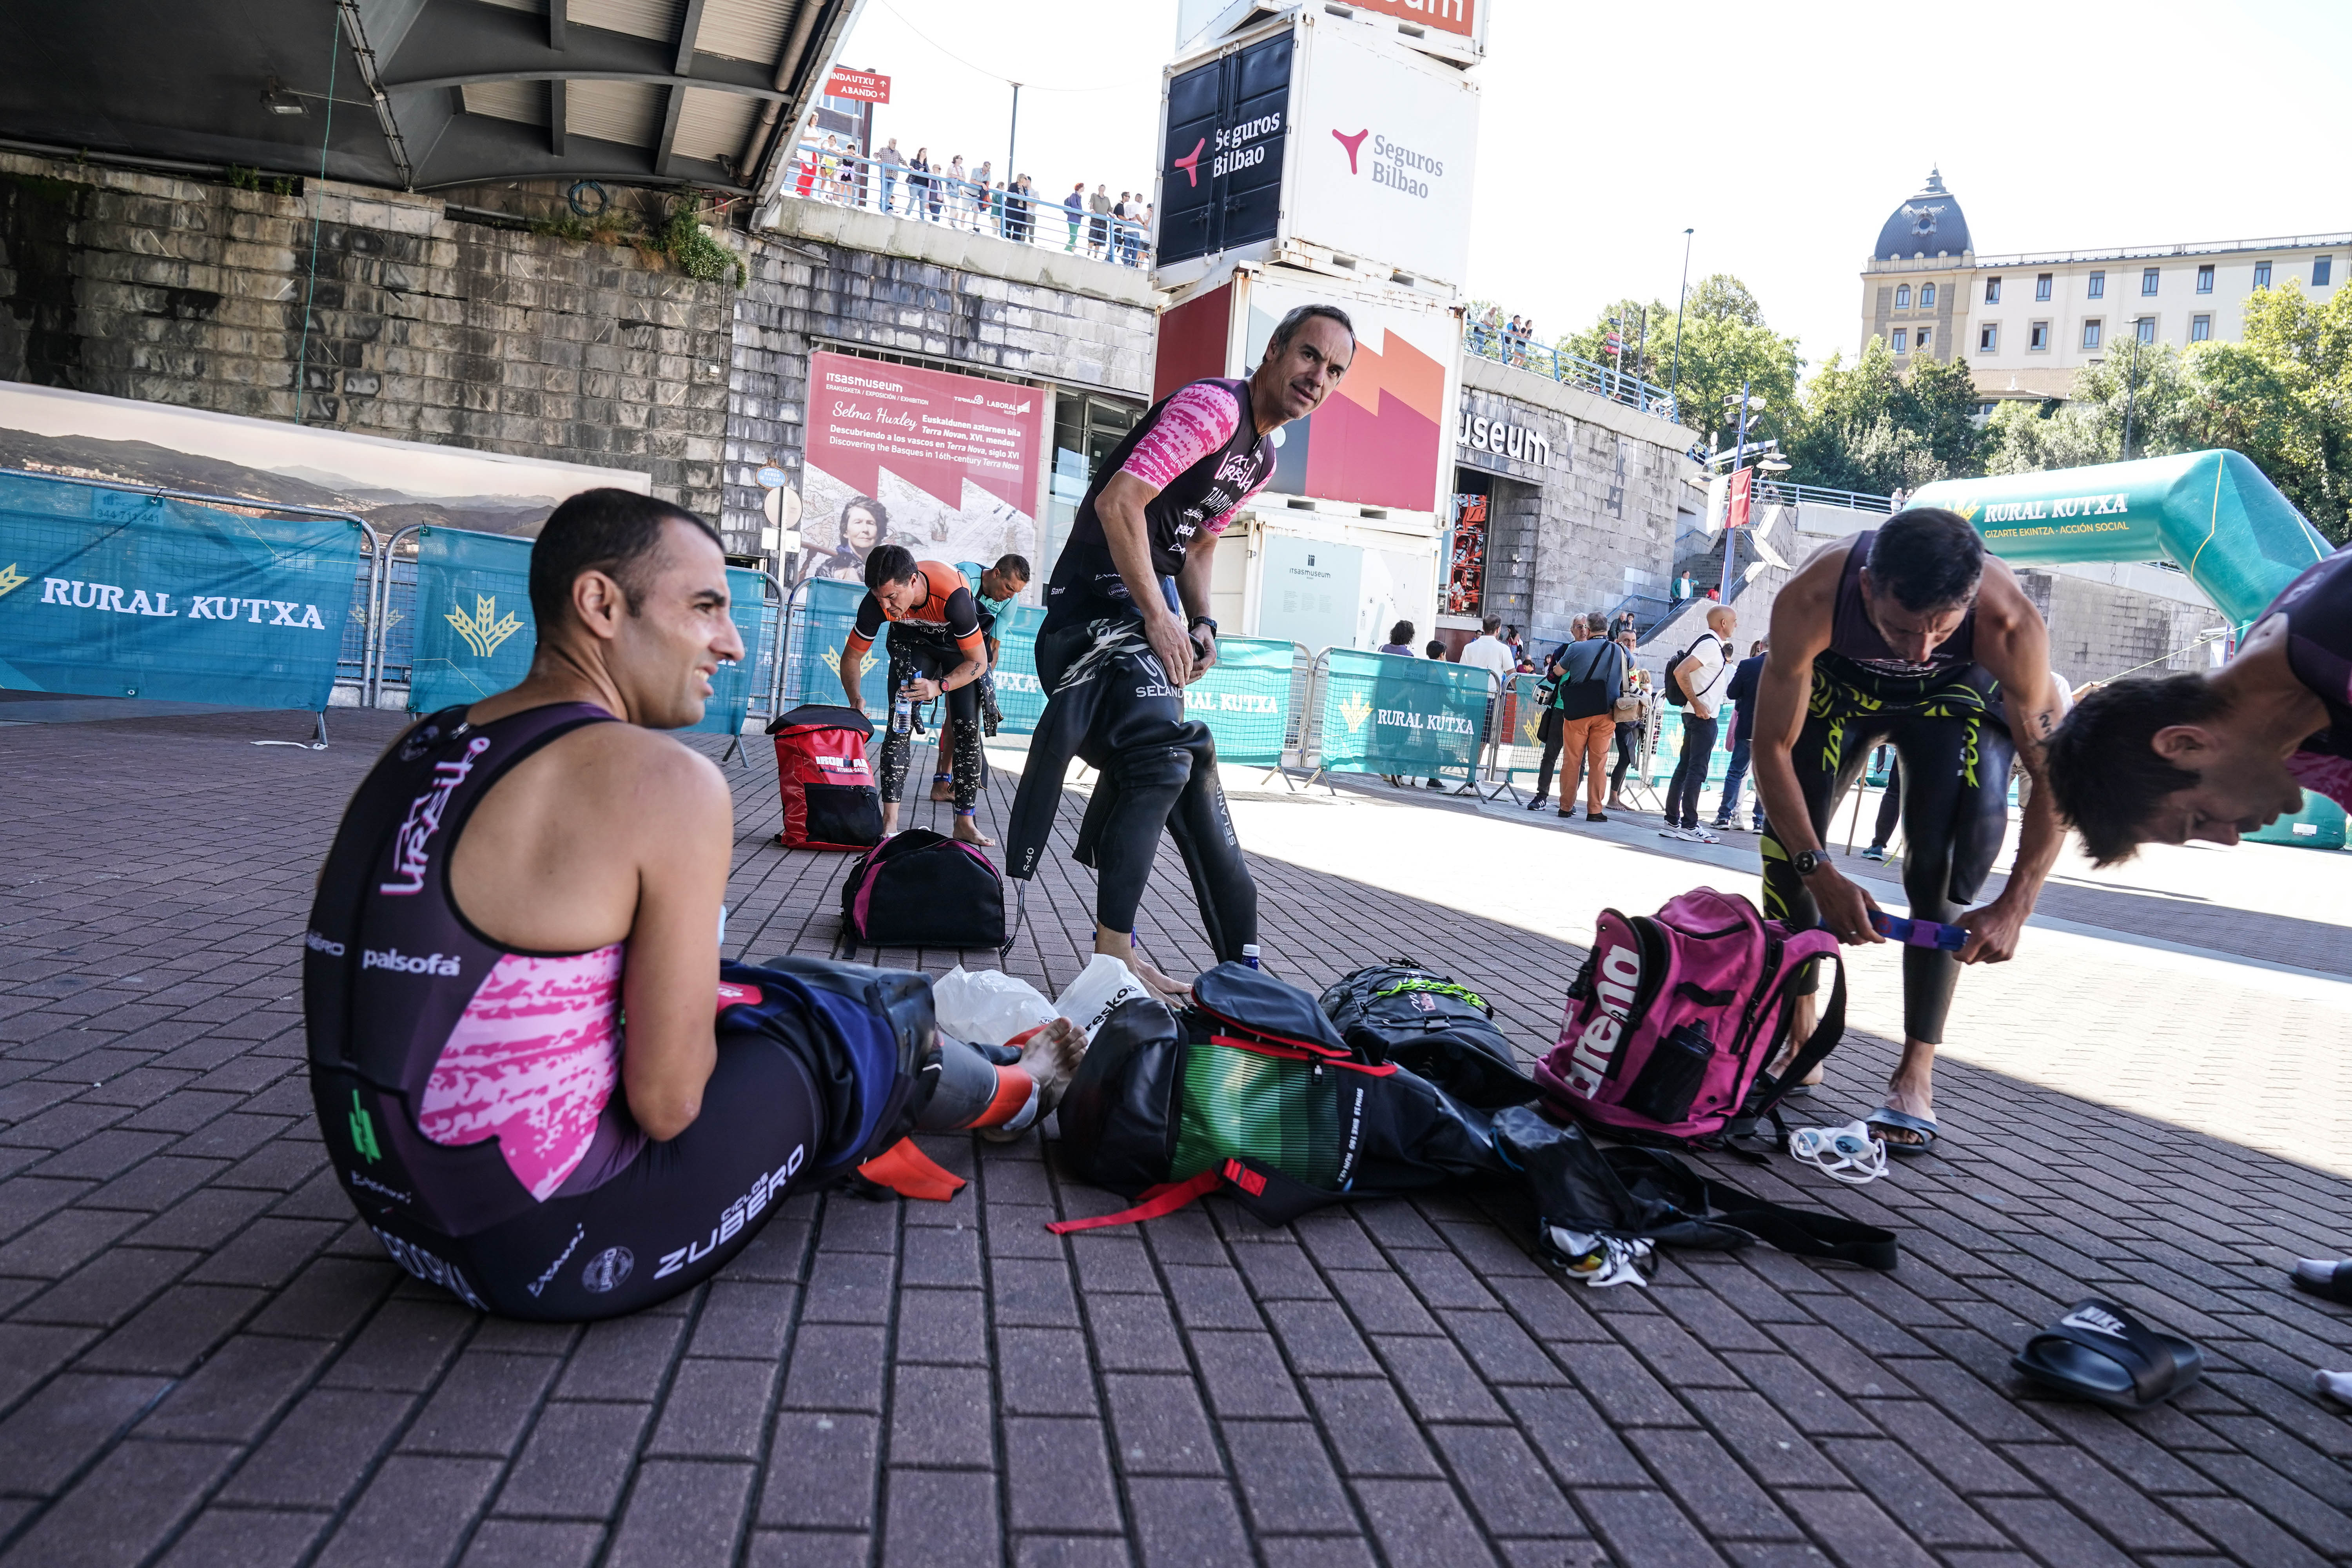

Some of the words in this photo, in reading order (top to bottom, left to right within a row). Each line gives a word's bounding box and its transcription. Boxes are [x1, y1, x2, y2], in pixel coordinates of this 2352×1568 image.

[831, 73, 875, 85] INDAUTXU
[841, 86, 878, 98] ABANDO
[1215, 112, 1280, 152] Seguros
[1213, 145, 1265, 178] Bilbao
[1374, 134, 1443, 178] Seguros
[1372, 161, 1428, 199] Bilbao
[826, 384, 861, 394] ERAKUSKETA
[865, 390, 896, 400] EXPOSICIÓN
[900, 396, 929, 405] EXHIBITION
[986, 400, 1016, 411] LABORAL
[832, 401, 873, 421] Selma
[875, 407, 918, 432] Huxley
[922, 415, 972, 430] Euskaldunen
[973, 423, 1006, 435] aztarnen
[1007, 428, 1021, 437] bila
[830, 424, 886, 440] Descubriendo
[894, 434, 906, 443] los
[907, 437, 934, 447] vascos
[947, 441, 966, 452] Terra
[967, 445, 987, 456] Nova,
[988, 448, 1007, 459] siglo
[1007, 451, 1020, 460] XVI
[922, 426, 942, 436] Terra
[943, 429, 969, 441] Novan,
[969, 433, 984, 443] XVI.
[986, 436, 1015, 447] mendea
[829, 436, 876, 452] Discovering
[877, 443, 890, 452] the
[891, 445, 924, 457] Basques
[926, 450, 933, 459] in
[935, 451, 982, 466] 16th-century
[983, 458, 1000, 468] Terra
[1002, 461, 1019, 471] Nova
[1149, 433, 1185, 473] ZUBERO
[1984, 501, 2047, 523] RURAL
[2051, 493, 2129, 518] KUTXA
[1985, 528, 2018, 539] GIZARTE
[2019, 527, 2054, 537] EKINTZA
[2060, 522, 2093, 534] ACCIÓN
[2095, 521, 2129, 532] SOCIAL
[41, 577, 178, 617] RURAL
[189, 595, 325, 630] KUTXA
[1136, 685, 1184, 699] SELAND
[1220, 693, 1278, 713] KUTXA
[1377, 709, 1423, 729] RURAL
[1426, 714, 1474, 735] KUTXA
[1217, 784, 1236, 846] SELAND
[362, 948, 461, 976] palsofa
[1564, 944, 1641, 1099] arena
[1351, 1118, 1360, 1136] BIKE
[1343, 1152, 1354, 1170] RUN
[653, 1143, 804, 1280] ZUBERO
[720, 1172, 769, 1222] CICLOS
[2078, 1306, 2127, 1332] NIKE
